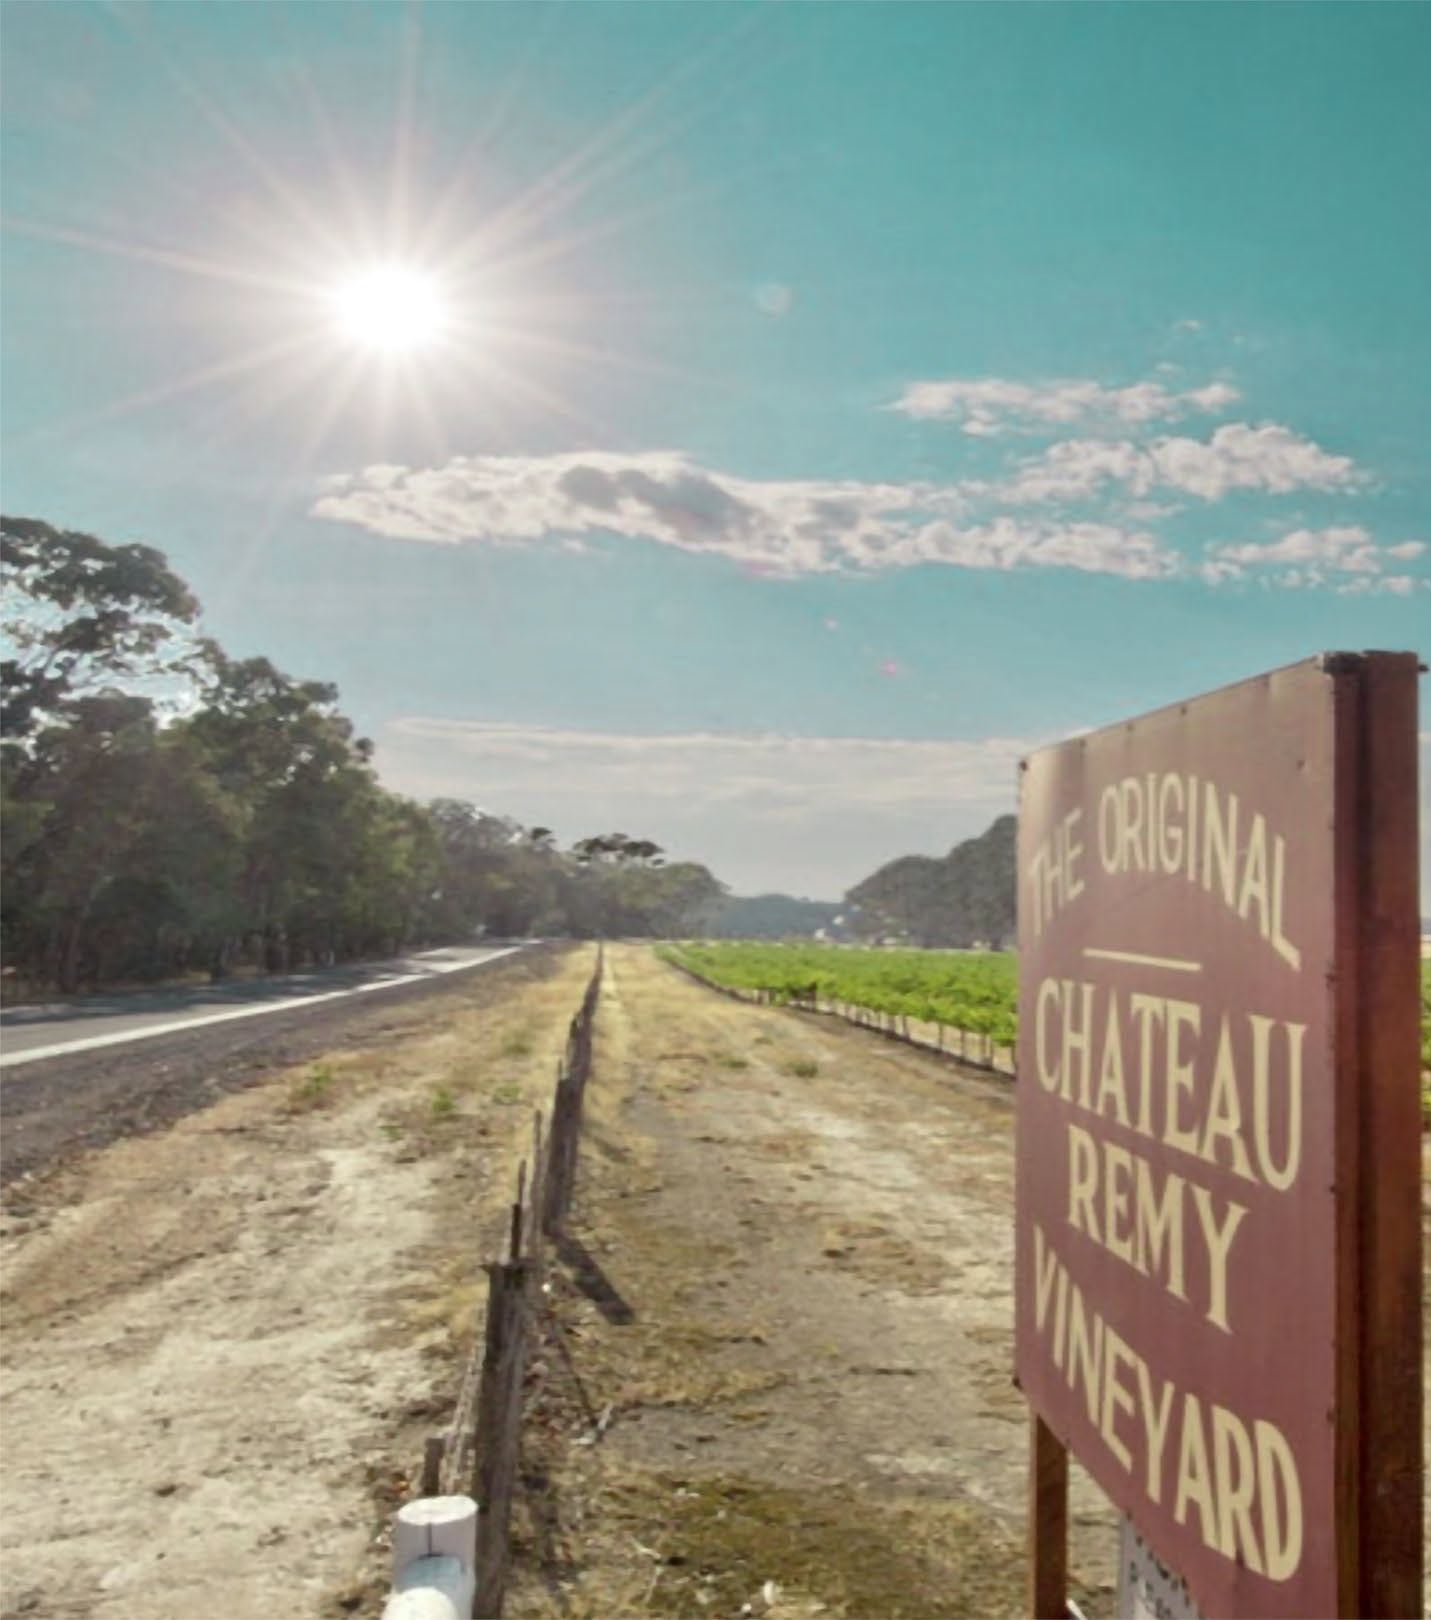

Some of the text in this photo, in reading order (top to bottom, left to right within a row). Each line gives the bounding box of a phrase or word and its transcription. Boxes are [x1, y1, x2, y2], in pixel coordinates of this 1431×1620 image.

[1028, 772, 1301, 971] THE ORIGINAL
[1035, 976, 1307, 1191] CHATEAU
[1068, 1124, 1250, 1335] REMY
[1033, 1224, 1303, 1583] VINEYARD
